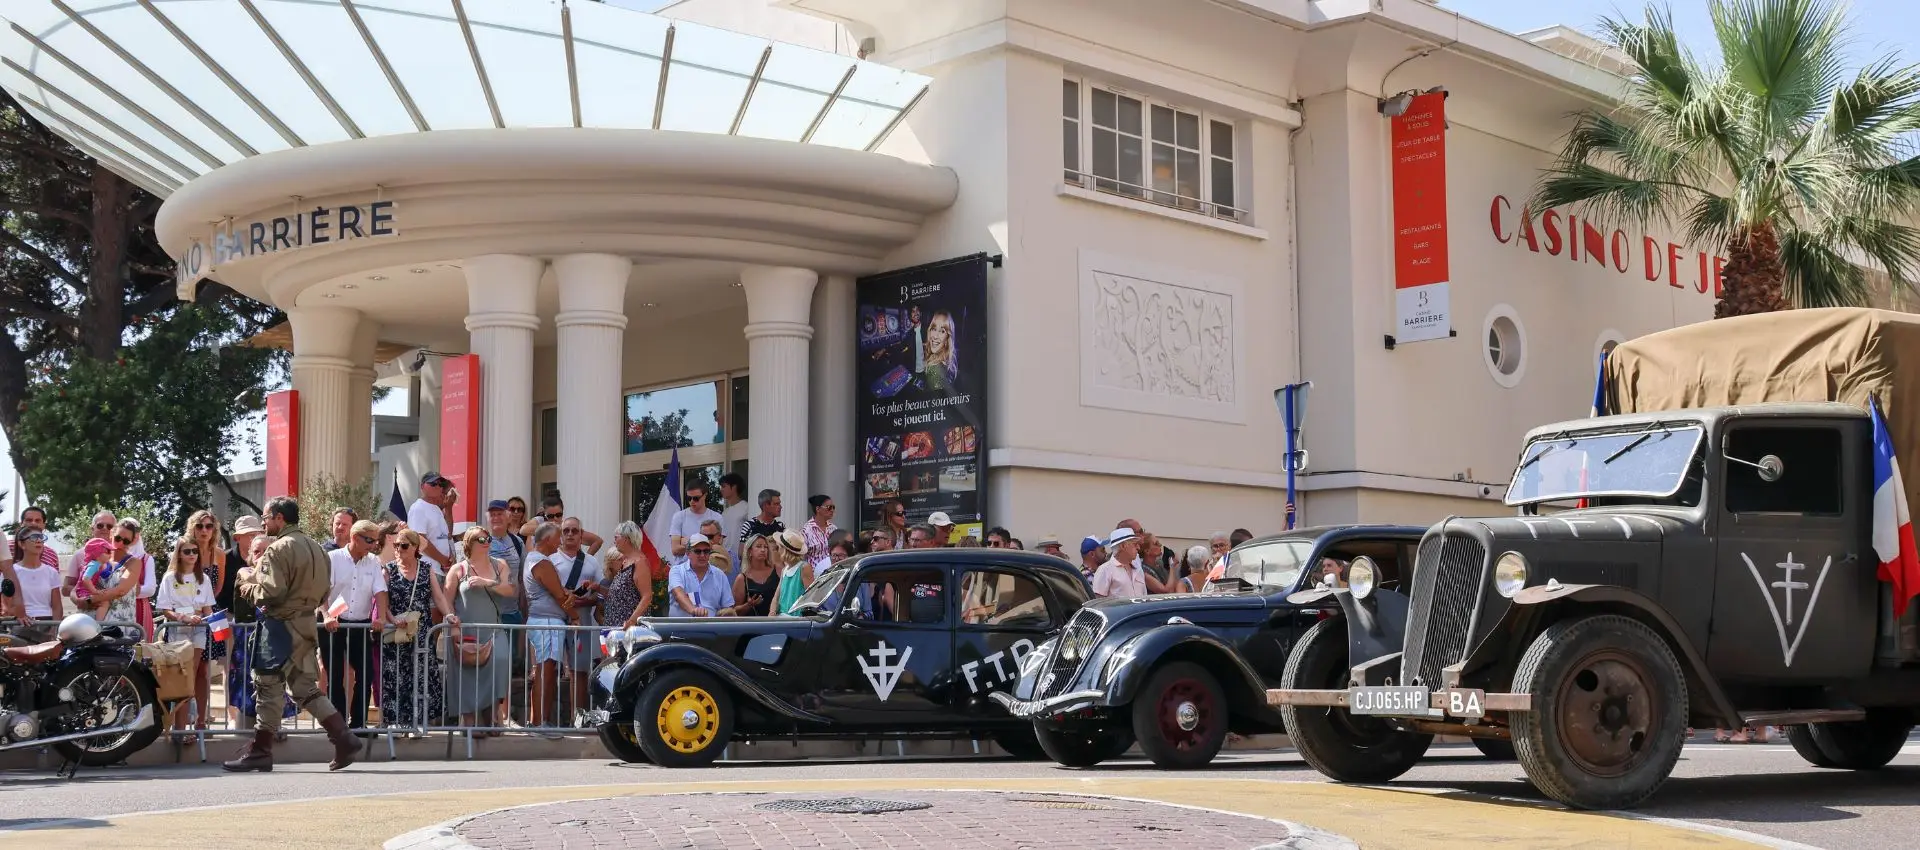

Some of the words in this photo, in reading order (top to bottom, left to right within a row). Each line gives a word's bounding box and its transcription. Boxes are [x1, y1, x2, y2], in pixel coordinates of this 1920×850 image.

[1423, 134, 1441, 144] TABLE
[1490, 194, 1630, 275] CASINO
[1643, 235, 1685, 289] DE
[872, 404, 886, 415] Vos
[886, 401, 903, 416] plus
[905, 398, 931, 412] beaux
[931, 394, 971, 408] souvenirs
[893, 417, 903, 427] se
[904, 413, 931, 428] jouent
[933, 410, 946, 422] ici.
[1356, 690, 1422, 710] CJ.065.HP
[1450, 691, 1482, 714] BA
